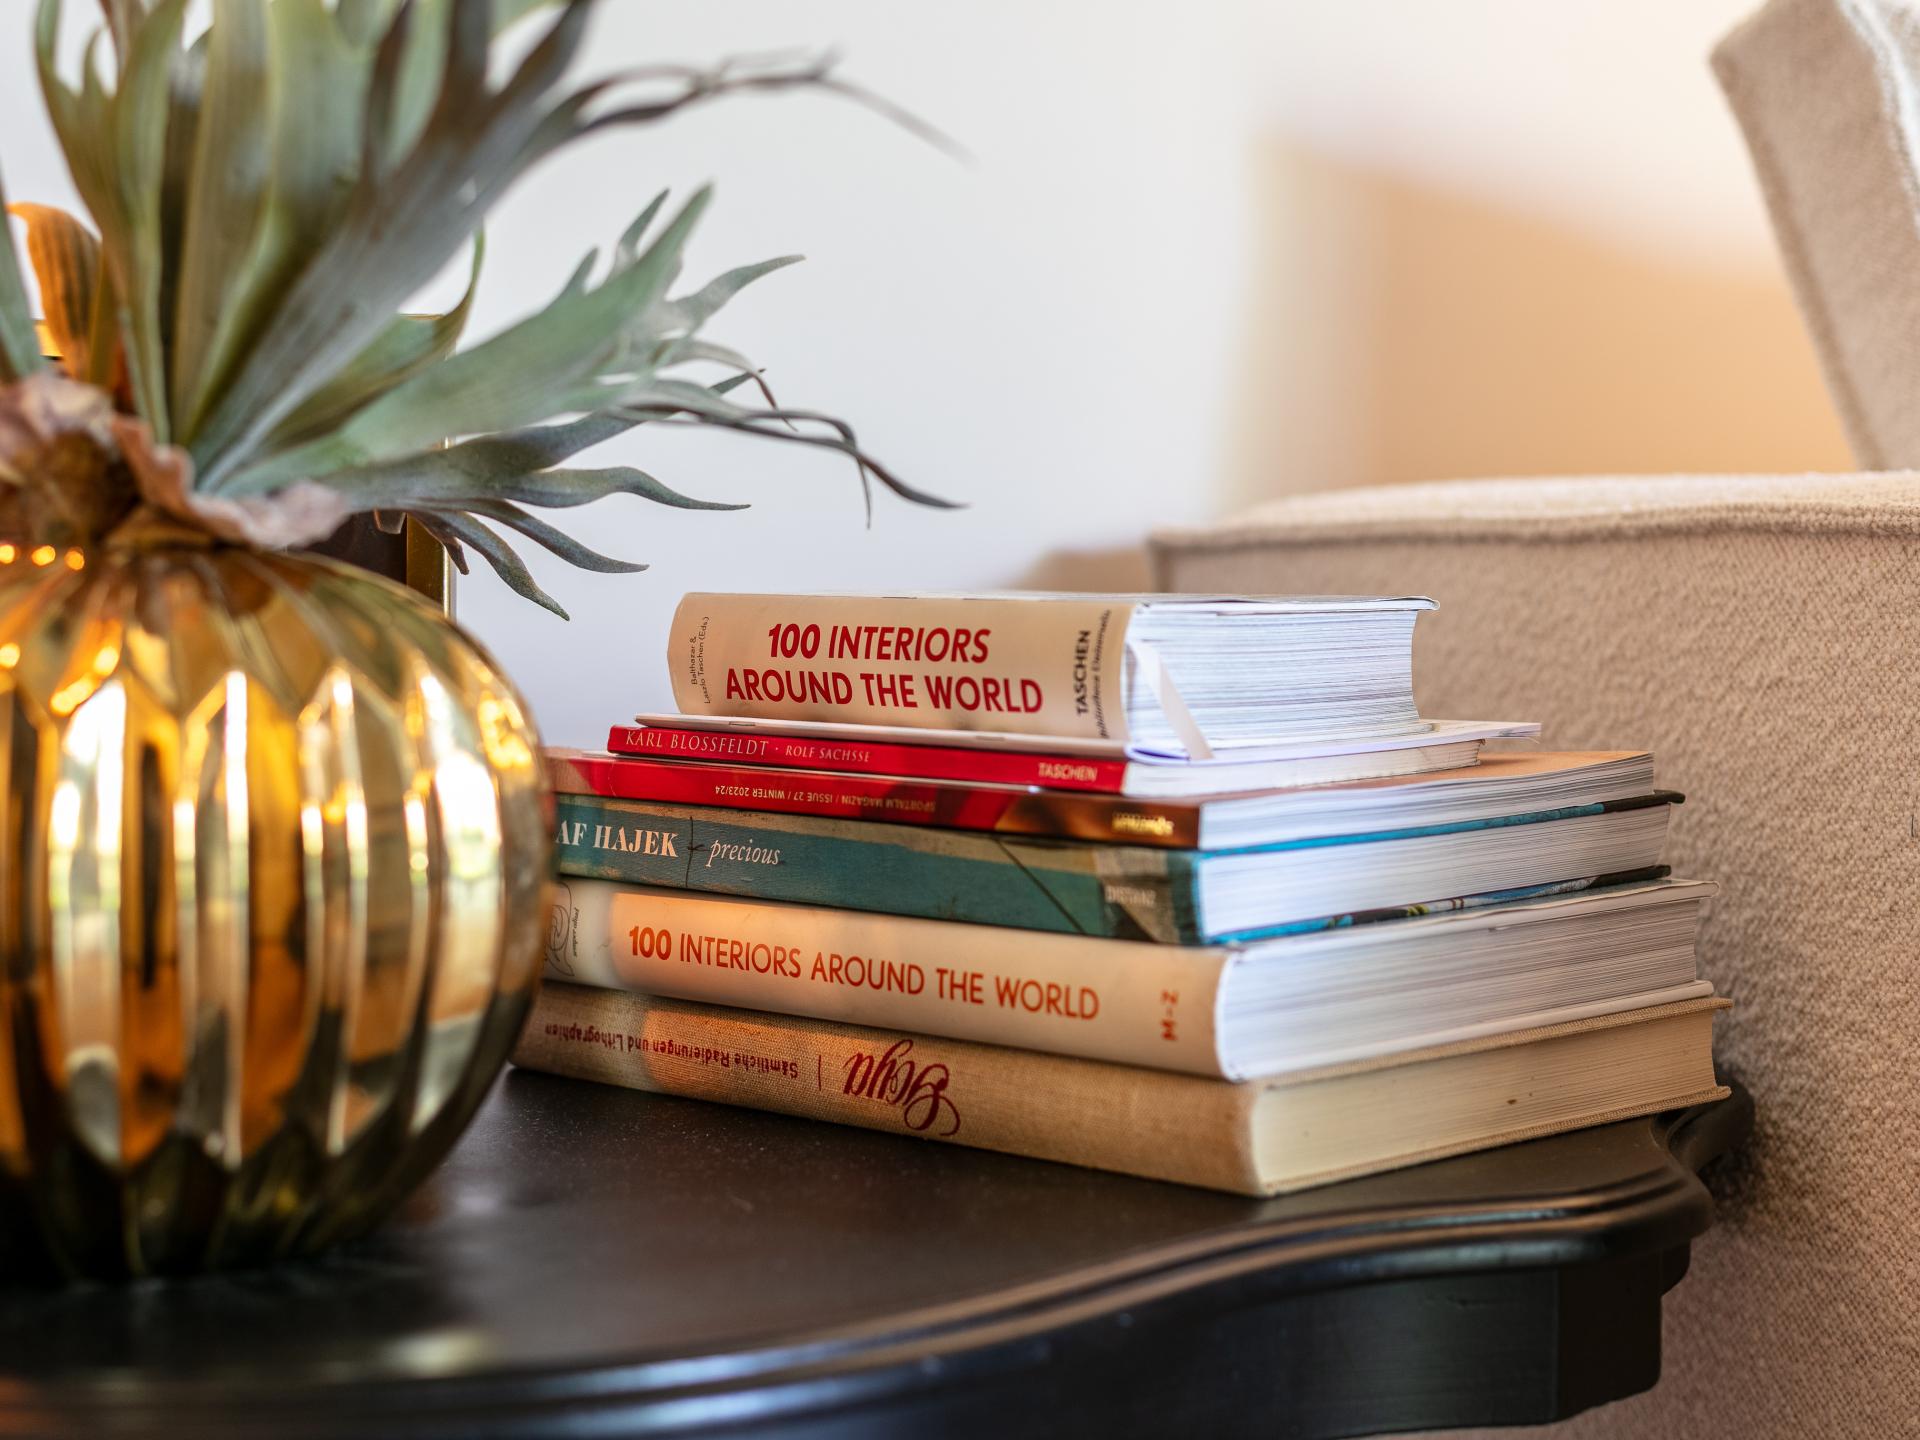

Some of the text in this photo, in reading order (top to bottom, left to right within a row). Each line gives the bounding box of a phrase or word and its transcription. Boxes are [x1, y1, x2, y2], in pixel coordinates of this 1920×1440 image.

[689, 636, 698, 685] Balthazar &
[697, 616, 711, 704] Laszlo Taschen (Eds.)
[769, 623, 991, 664] 100 INTERIORS
[726, 668, 1043, 713] AROUND THE WORLD
[1073, 630, 1091, 716] TASCHEN
[625, 730, 870, 763] KARL BLOSSFELDT ROLF SACHSSE
[715, 784, 750, 798] 2023/24
[1038, 762, 1097, 781] TASCHEN
[752, 787, 785, 800] WINTER
[793, 789, 804, 801] 27
[807, 791, 833, 804] ISSUE
[841, 794, 883, 809] MAGAZIN
[593, 824, 680, 858] HAJEK
[705, 838, 780, 867] precious
[629, 925, 672, 960] 100
[680, 933, 801, 978] INTERIORS
[811, 951, 925, 995] AROUND
[936, 968, 984, 1005] THE
[994, 976, 1099, 1020] WORLD
[545, 1022, 960, 1136] Goya Sämtliche Radierungen und Lithographien
